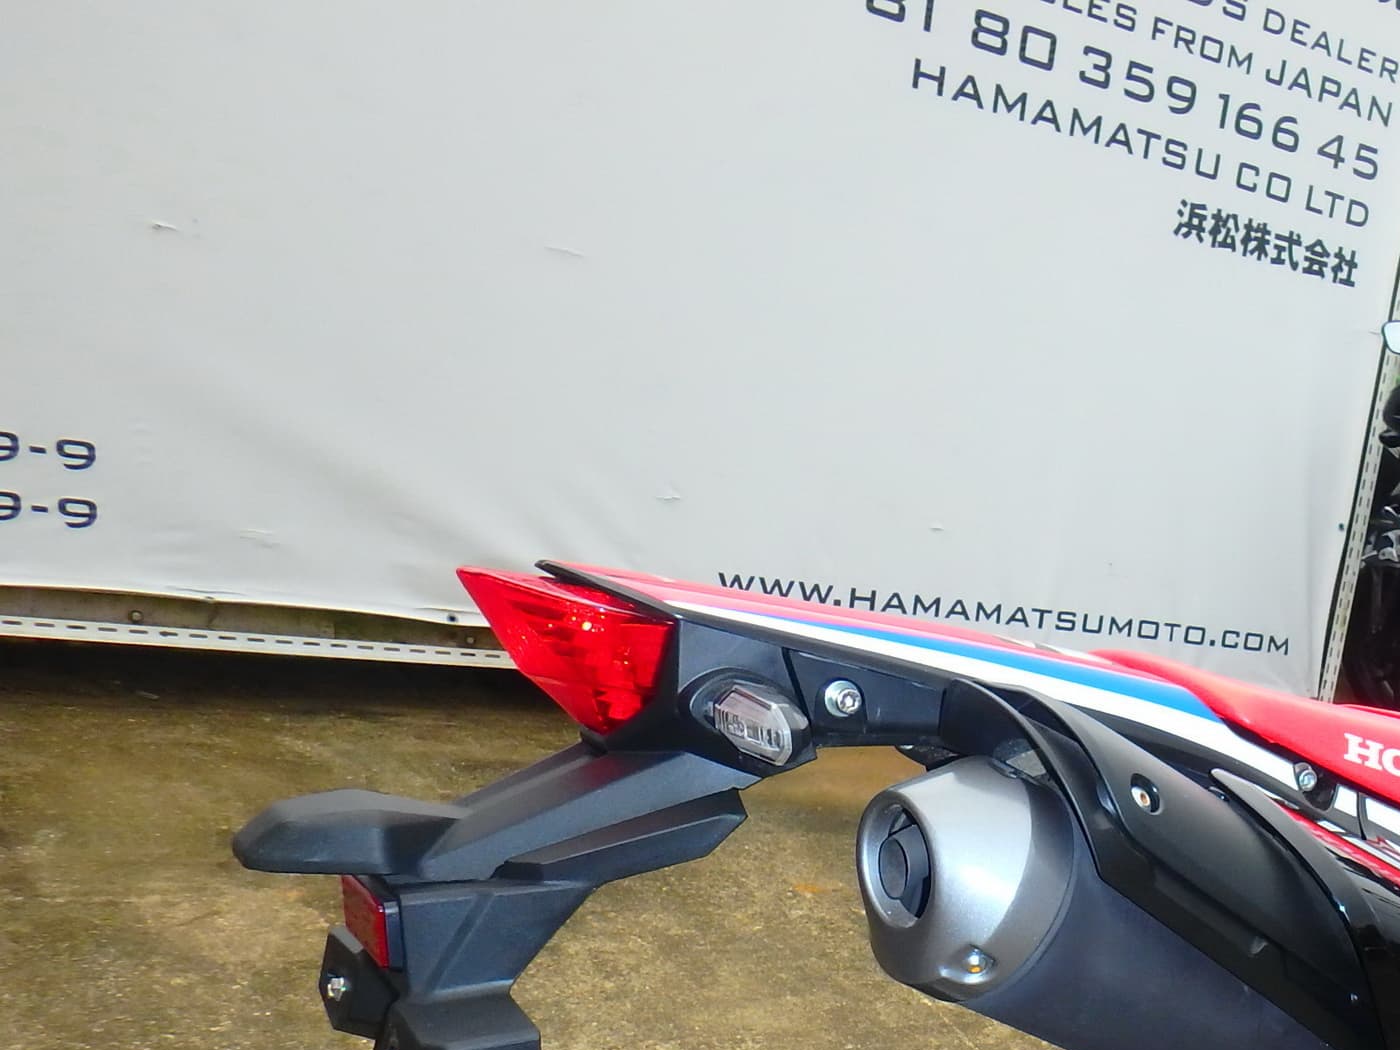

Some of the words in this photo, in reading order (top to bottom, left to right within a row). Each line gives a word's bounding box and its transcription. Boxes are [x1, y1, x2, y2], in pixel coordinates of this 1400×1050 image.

[970, 8, 1057, 71] 80
[1078, 45, 1198, 115] 359
[1217, 93, 1300, 153] 166
[1316, 134, 1379, 180] 45
[1151, 16, 1254, 76] FROM
[1264, 59, 1393, 128] JAPAN
[1262, 7, 1400, 84] DEALER
[911, 57, 1221, 180] HAMAMATSU
[1235, 161, 1293, 204] CO
[1304, 184, 1370, 228] LTD
[1172, 198, 1359, 288] 浜松株式会社
[717, 571, 1290, 656] WWW.HAMAMATSUMOTO.COM
